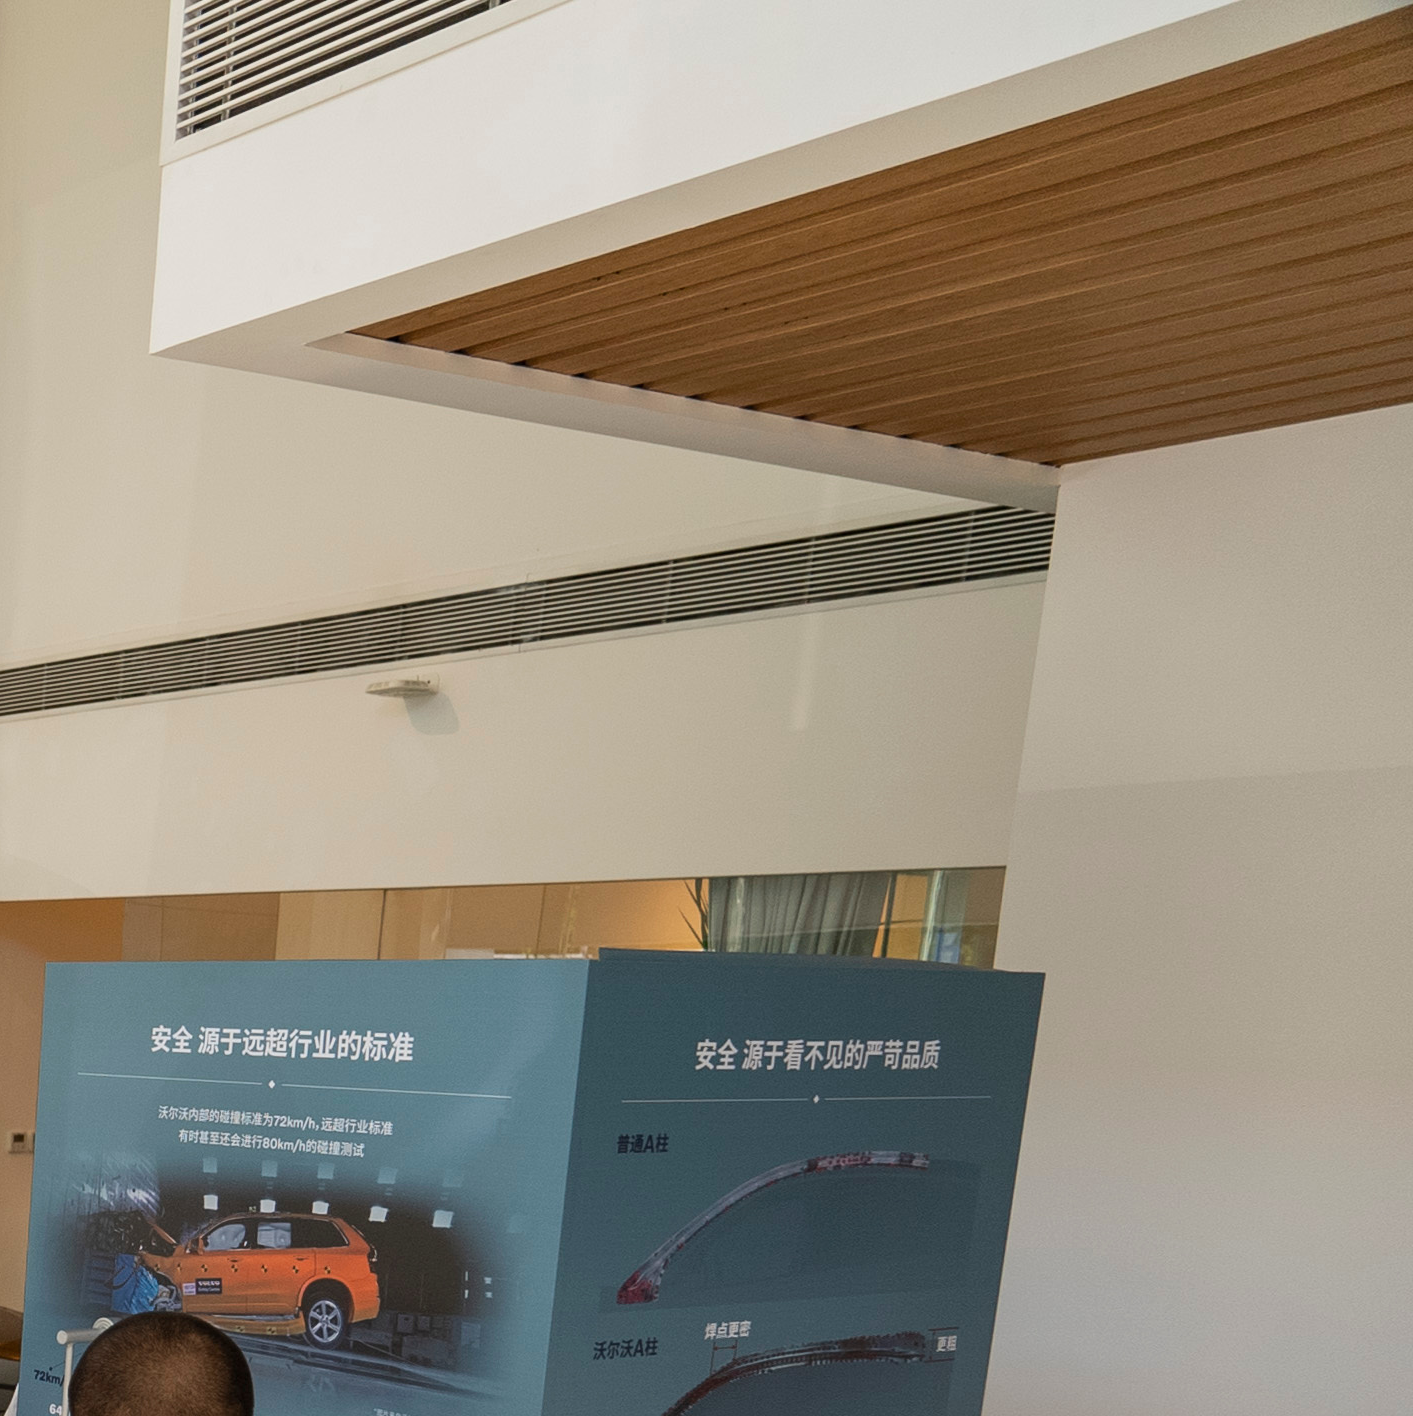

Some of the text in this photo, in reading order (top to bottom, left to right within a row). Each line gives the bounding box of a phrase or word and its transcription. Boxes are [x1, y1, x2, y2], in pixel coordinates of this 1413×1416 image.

[150, 1025, 415, 1062] 安全 源于远超行业的标准
[695, 1038, 941, 1071] 安全 源于看不见的严苛品质
[178, 1129, 365, 1158] 有时甚至还会进行80km/h的碰撞测试
[616, 1133, 669, 1155] 普通A柱
[704, 1320, 752, 1341] 焊点更密
[593, 1337, 659, 1361] 沃尔沃A柱
[34, 1369, 65, 1387] 72km/
